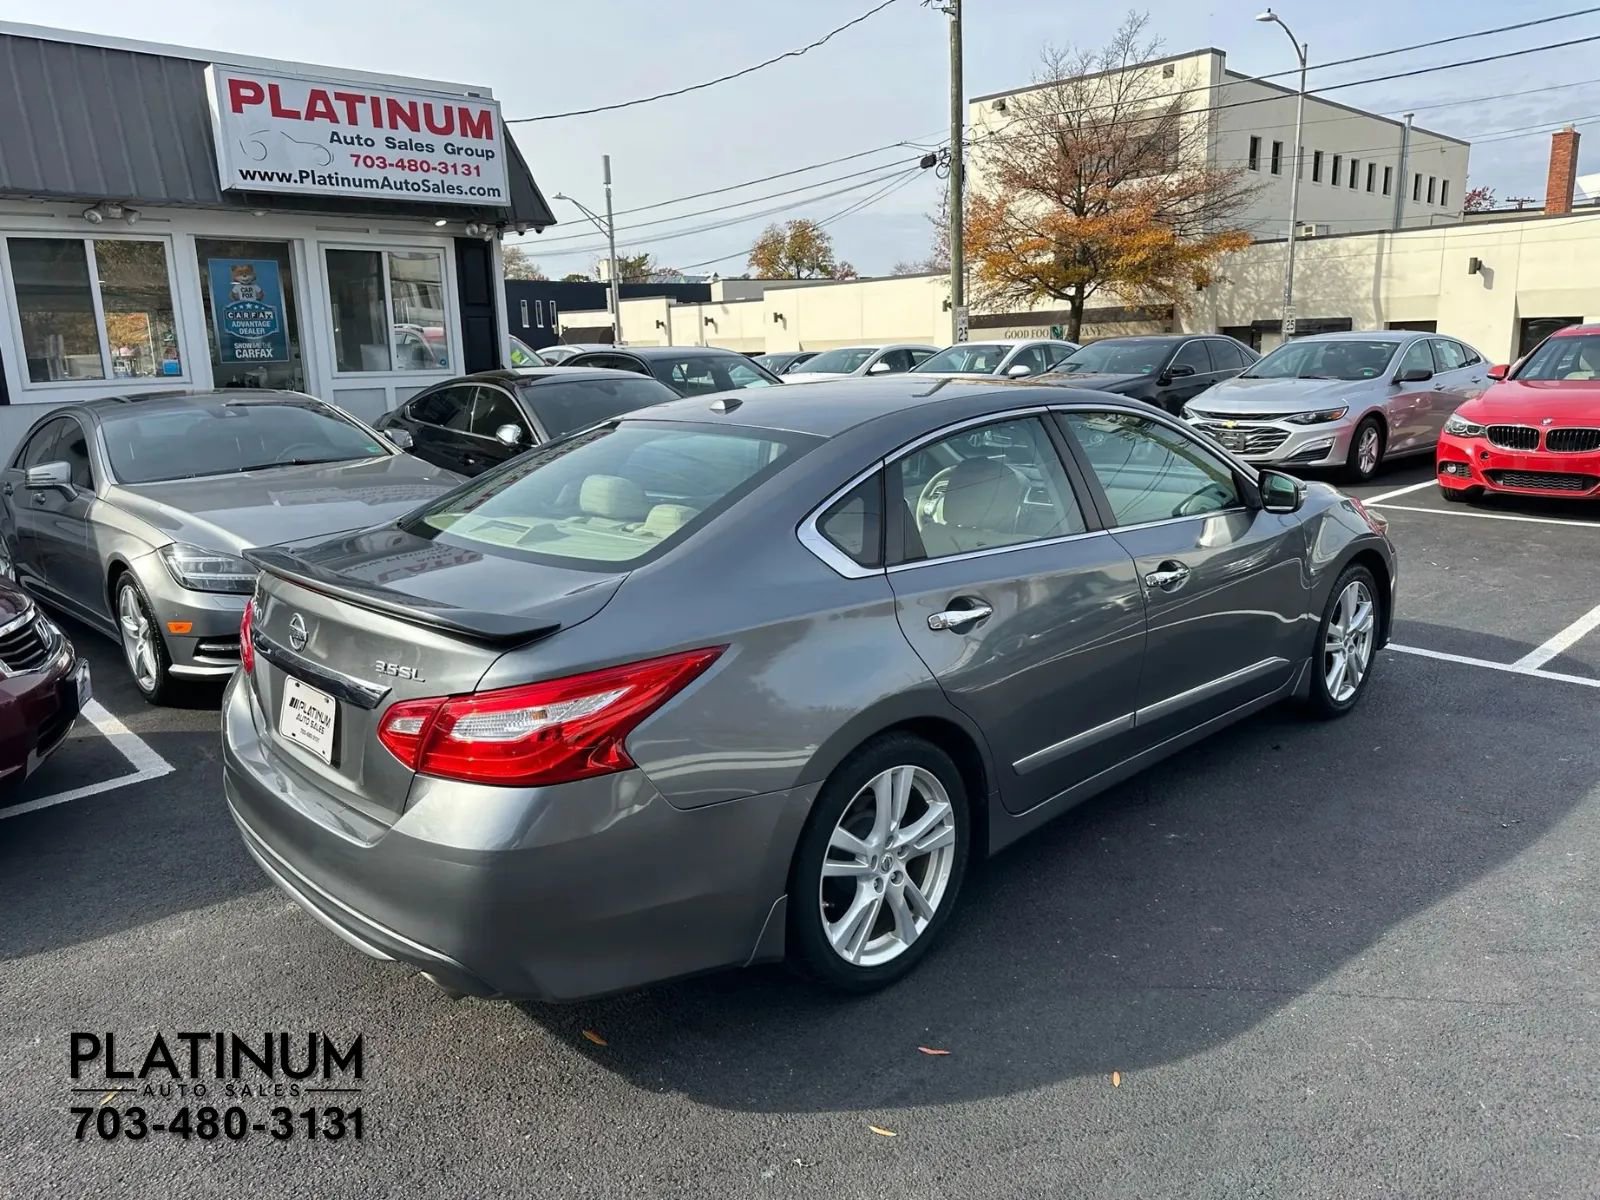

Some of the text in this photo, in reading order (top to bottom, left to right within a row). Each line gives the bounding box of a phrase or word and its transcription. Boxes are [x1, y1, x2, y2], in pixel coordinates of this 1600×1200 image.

[228, 78, 494, 140] PLATINUM
[329, 131, 496, 160] Auto Sales Group
[350, 153, 482, 178] 703-480-3131
[238, 168, 501, 198] www.PlatinumAutoSales.com
[228, 311, 273, 319] CARFAX
[1286, 320, 1295, 330] 25
[958, 326, 969, 342] 25
[1004, 329, 1030, 339] GOOD
[235, 349, 273, 358] CARFAX
[295, 713, 310, 726] AUTO
[310, 720, 325, 735] SALES
[300, 700, 331, 728] PLATINUM
